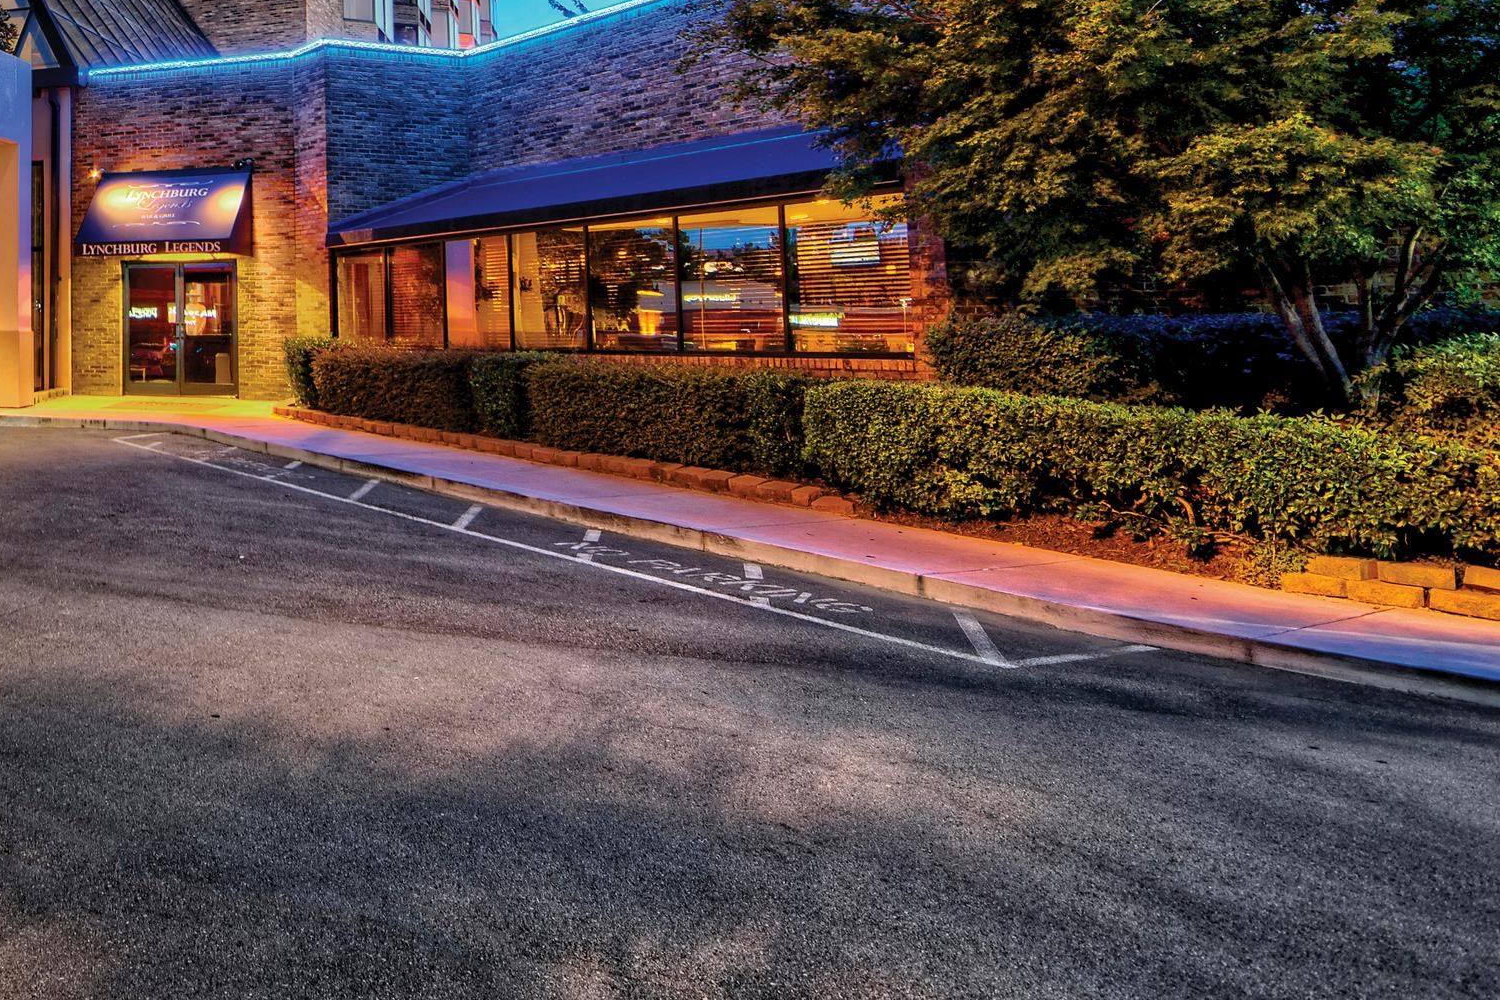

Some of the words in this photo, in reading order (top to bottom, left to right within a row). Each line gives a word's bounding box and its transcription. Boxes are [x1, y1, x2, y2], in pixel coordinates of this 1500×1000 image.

[125, 187, 209, 201] LYNCHBURG
[82, 242, 158, 256] LYNCHBURG
[164, 240, 221, 254] LEGENDS
[554, 542, 630, 556] NO
[627, 559, 874, 613] PARKING
